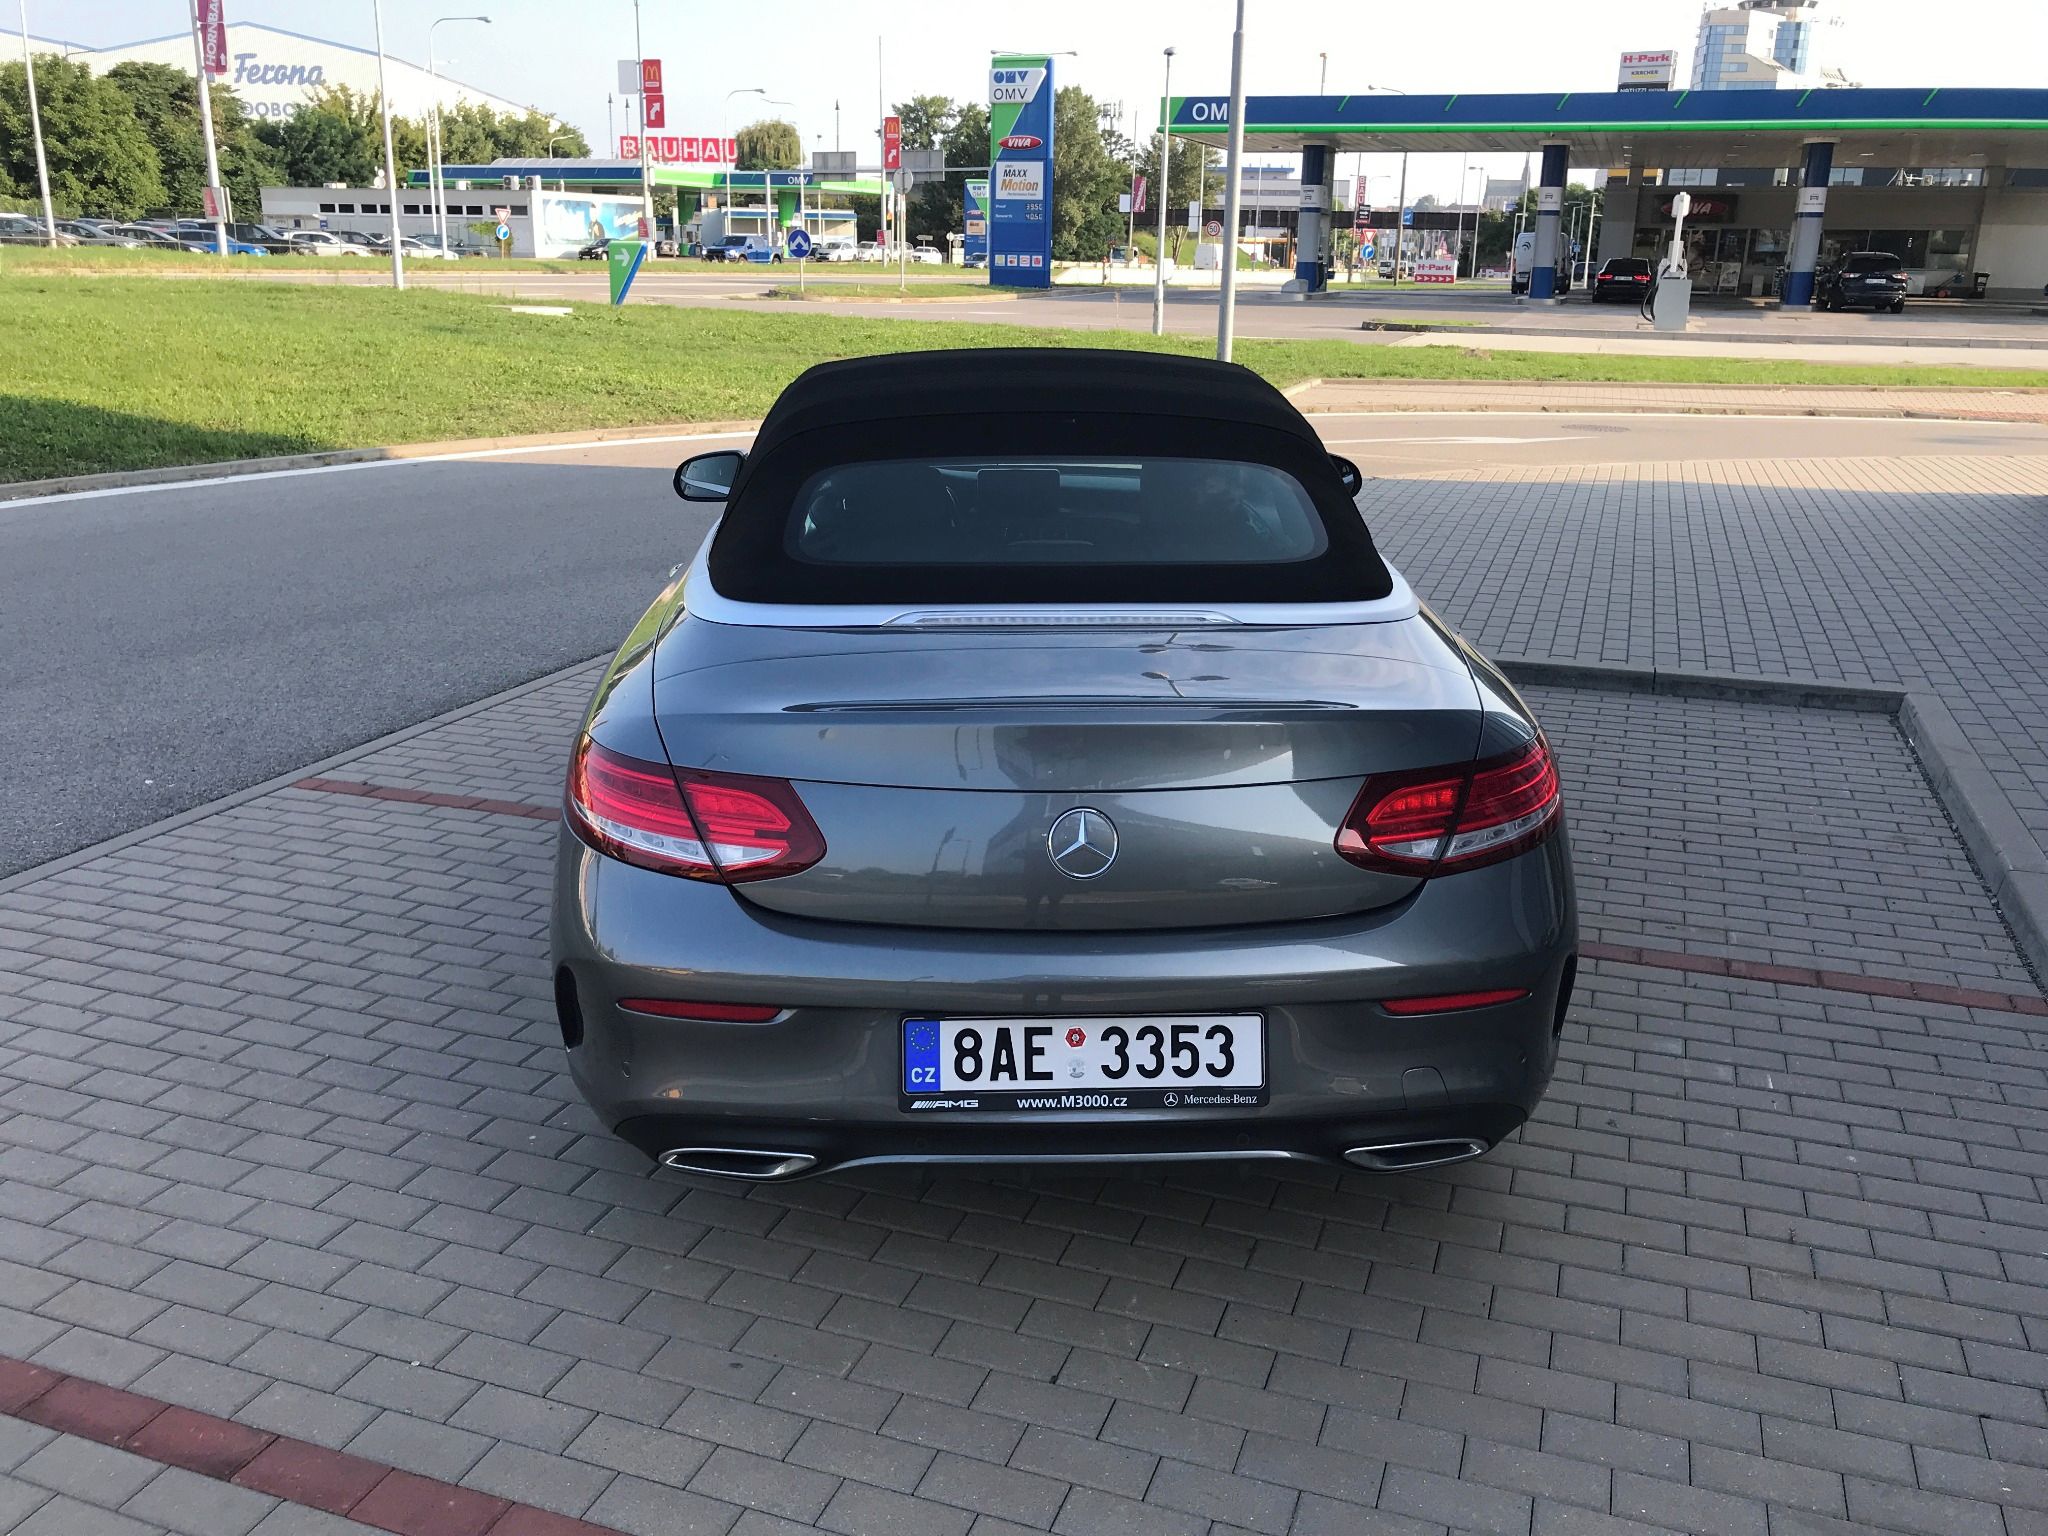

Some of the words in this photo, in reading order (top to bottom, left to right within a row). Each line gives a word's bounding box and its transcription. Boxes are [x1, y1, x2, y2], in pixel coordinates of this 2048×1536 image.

[206, 0, 219, 66] HORNBA
[1623, 54, 1670, 63] H-Park
[234, 53, 326, 85] Ferona
[994, 88, 1028, 100] OMV
[1192, 102, 1229, 121] OM
[622, 139, 738, 159] BAUHAU
[1008, 138, 1031, 147] VIVA
[1003, 169, 1028, 177] MAXX
[1001, 179, 1039, 191] Motion
[1209, 225, 1217, 233] 50
[953, 1027, 1054, 1082] 8AE
[1100, 1024, 1235, 1080] 3353
[911, 1066, 936, 1084] CZ
[1016, 1095, 1128, 1109] www.M3000.cz
[1184, 1094, 1258, 1105] Mercedes-Benz
